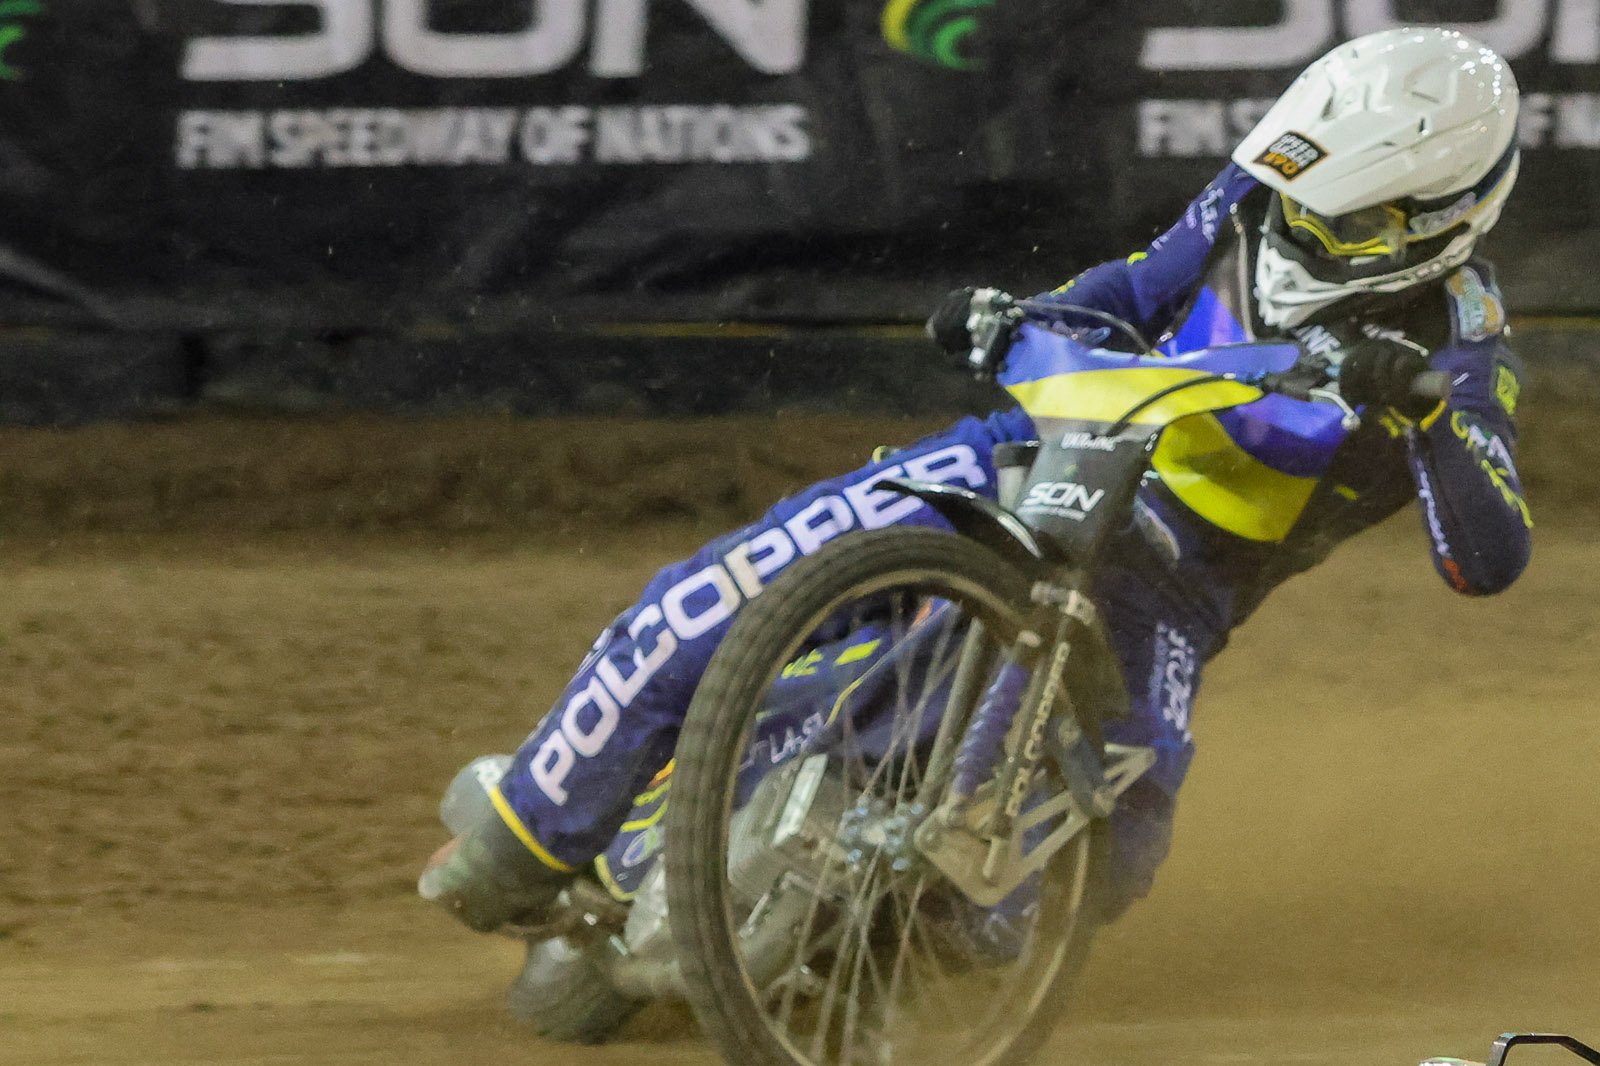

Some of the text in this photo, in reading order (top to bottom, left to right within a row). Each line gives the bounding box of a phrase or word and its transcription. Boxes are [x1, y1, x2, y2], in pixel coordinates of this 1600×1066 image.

[177, 102, 811, 169] FIM SPEEDWAY OF NATIONS
[1138, 100, 1226, 157] FIM
[1021, 481, 1106, 513] SON
[529, 443, 989, 807] POLCOPPER
